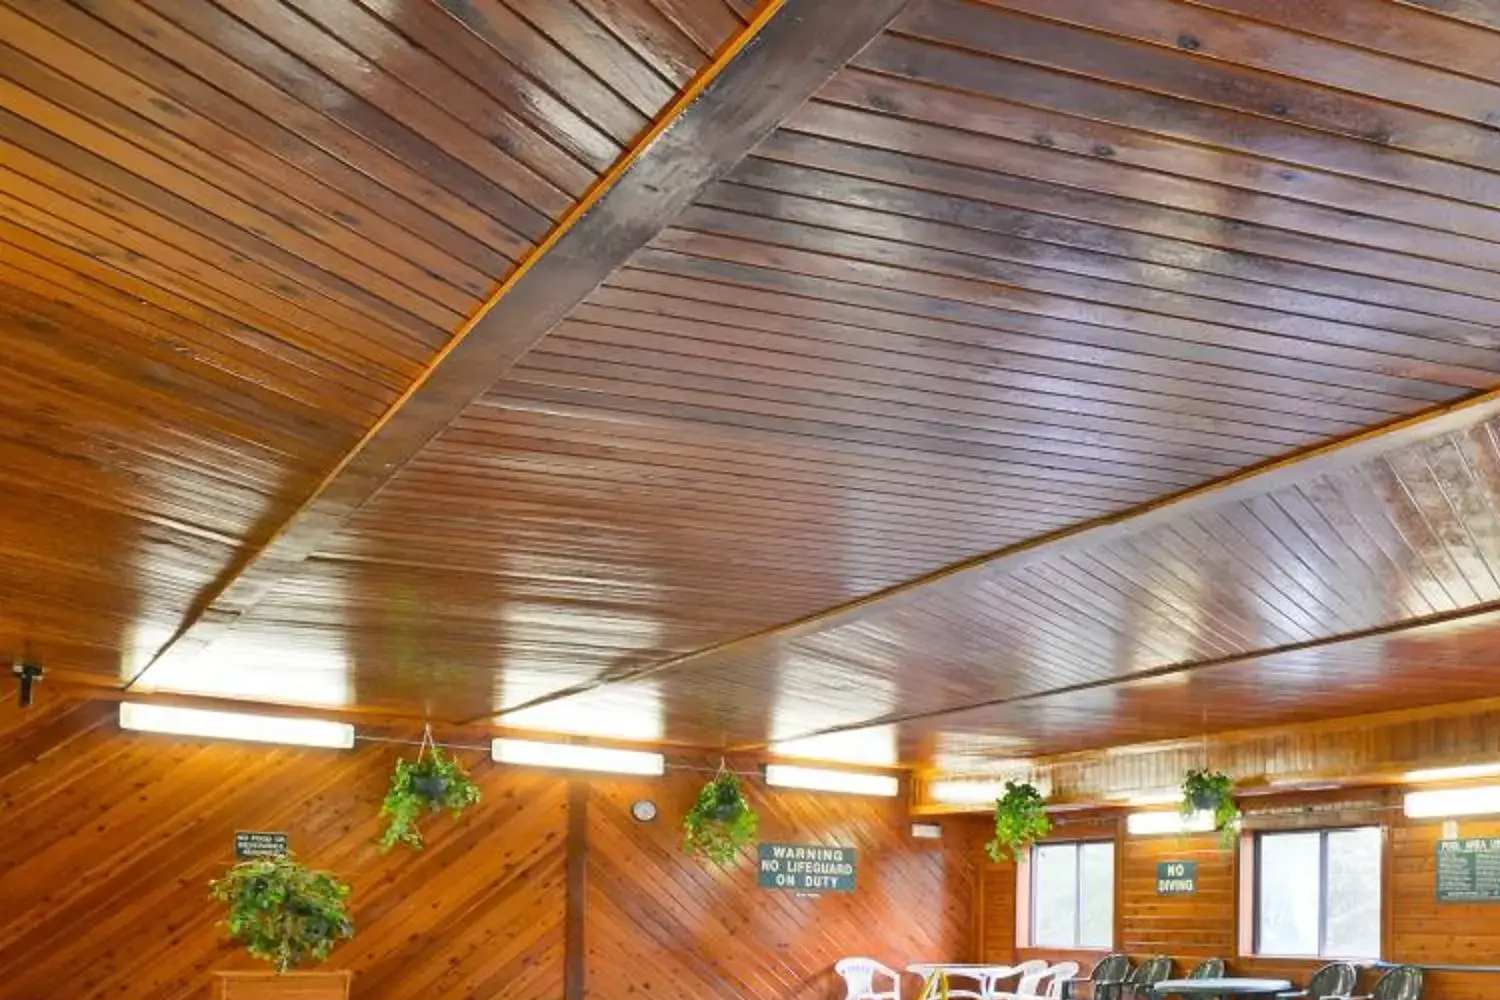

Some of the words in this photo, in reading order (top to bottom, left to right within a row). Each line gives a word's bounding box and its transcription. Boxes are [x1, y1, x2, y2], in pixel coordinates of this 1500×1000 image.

[772, 846, 843, 861] WARNING
[761, 859, 779, 872] NO
[787, 861, 853, 875] LIFEGUARD
[1167, 864, 1185, 877] NO
[775, 873, 796, 887] ON
[805, 875, 839, 889] DUTY
[1158, 879, 1193, 892] DIVING
